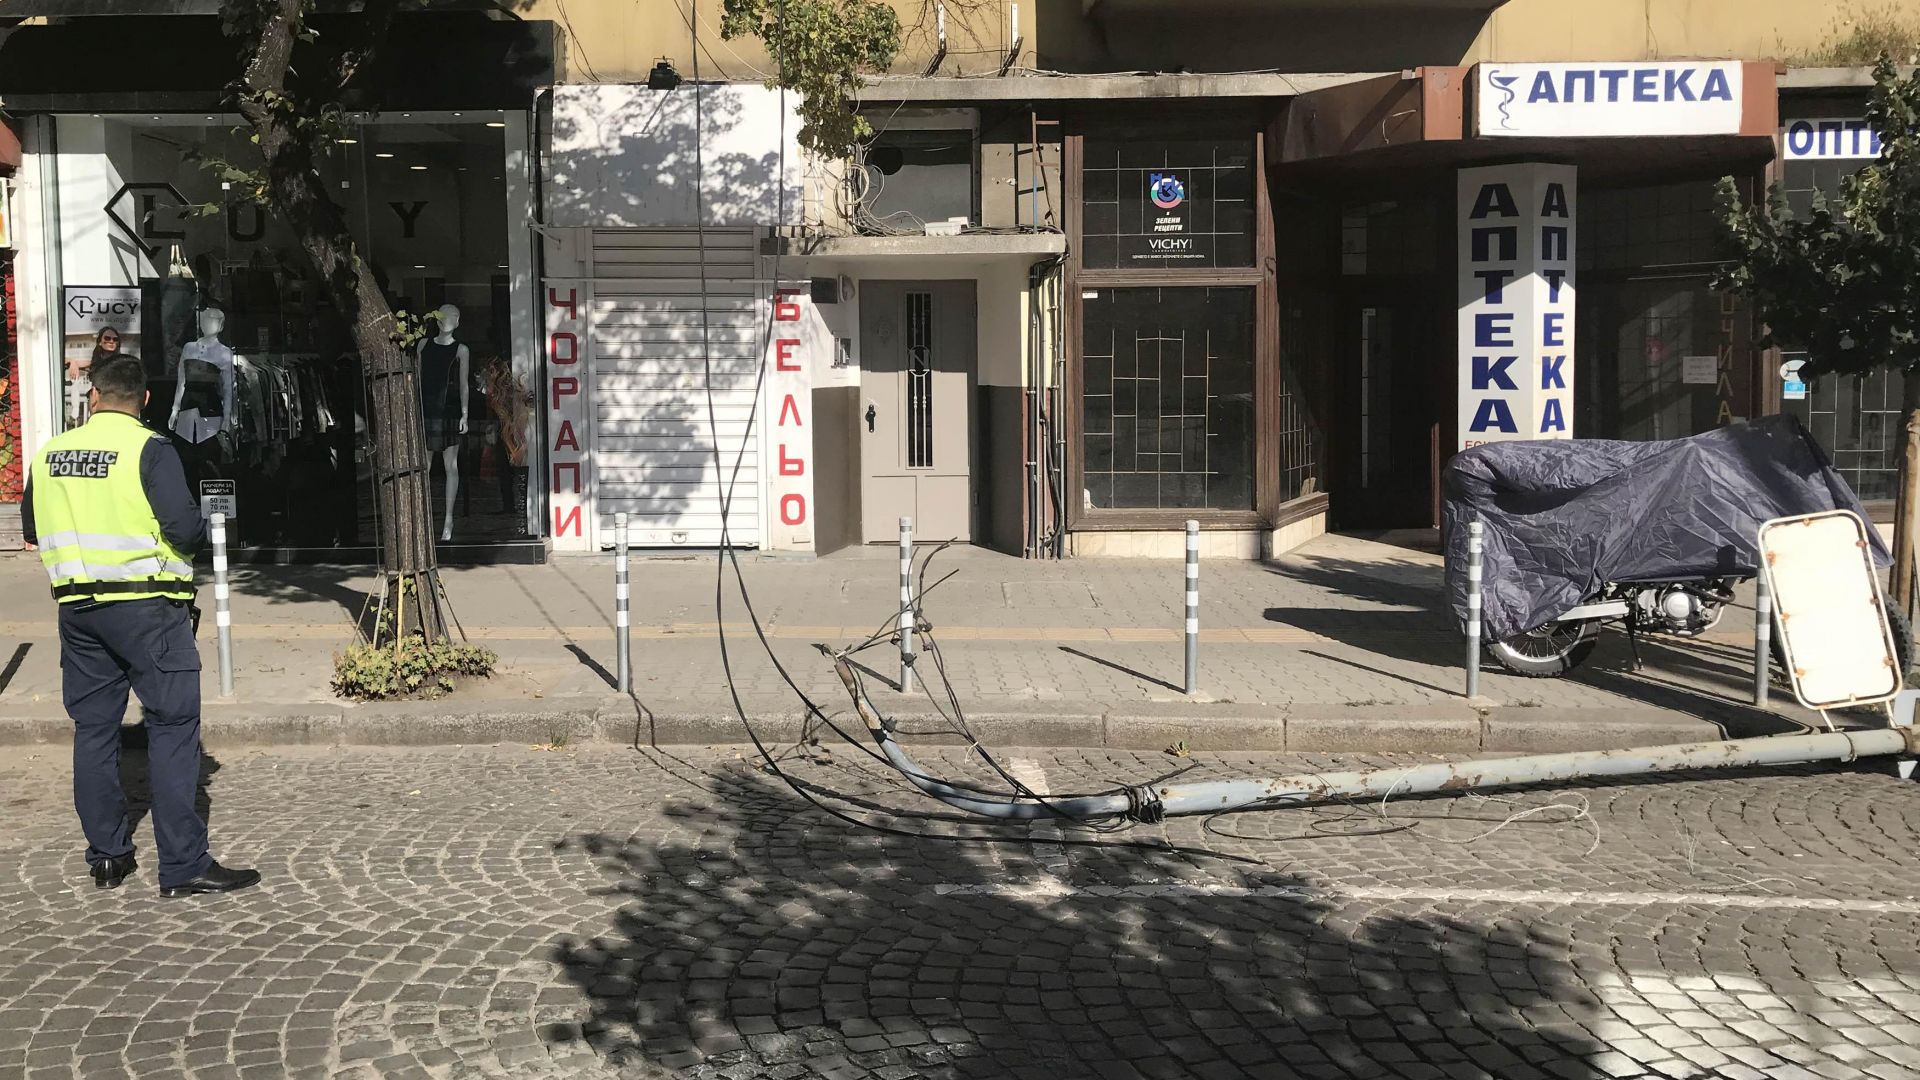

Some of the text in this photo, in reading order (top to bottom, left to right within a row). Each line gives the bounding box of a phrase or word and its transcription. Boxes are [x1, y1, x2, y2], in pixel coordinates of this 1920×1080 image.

[1527, 69, 1733, 103] АПТЕКА
[143, 194, 429, 242] LUY
[1149, 239, 1189, 249] VICHY
[80, 300, 138, 314] LUCY
[1469, 183, 1520, 433] АПТЕКА
[1540, 183, 1569, 433] АПТЕКА
[550, 288, 582, 537] ЧОРАПИ
[775, 289, 806, 525] БЕЛЬО
[47, 450, 117, 464] TRAFFIC
[50, 463, 107, 477] POLICE
